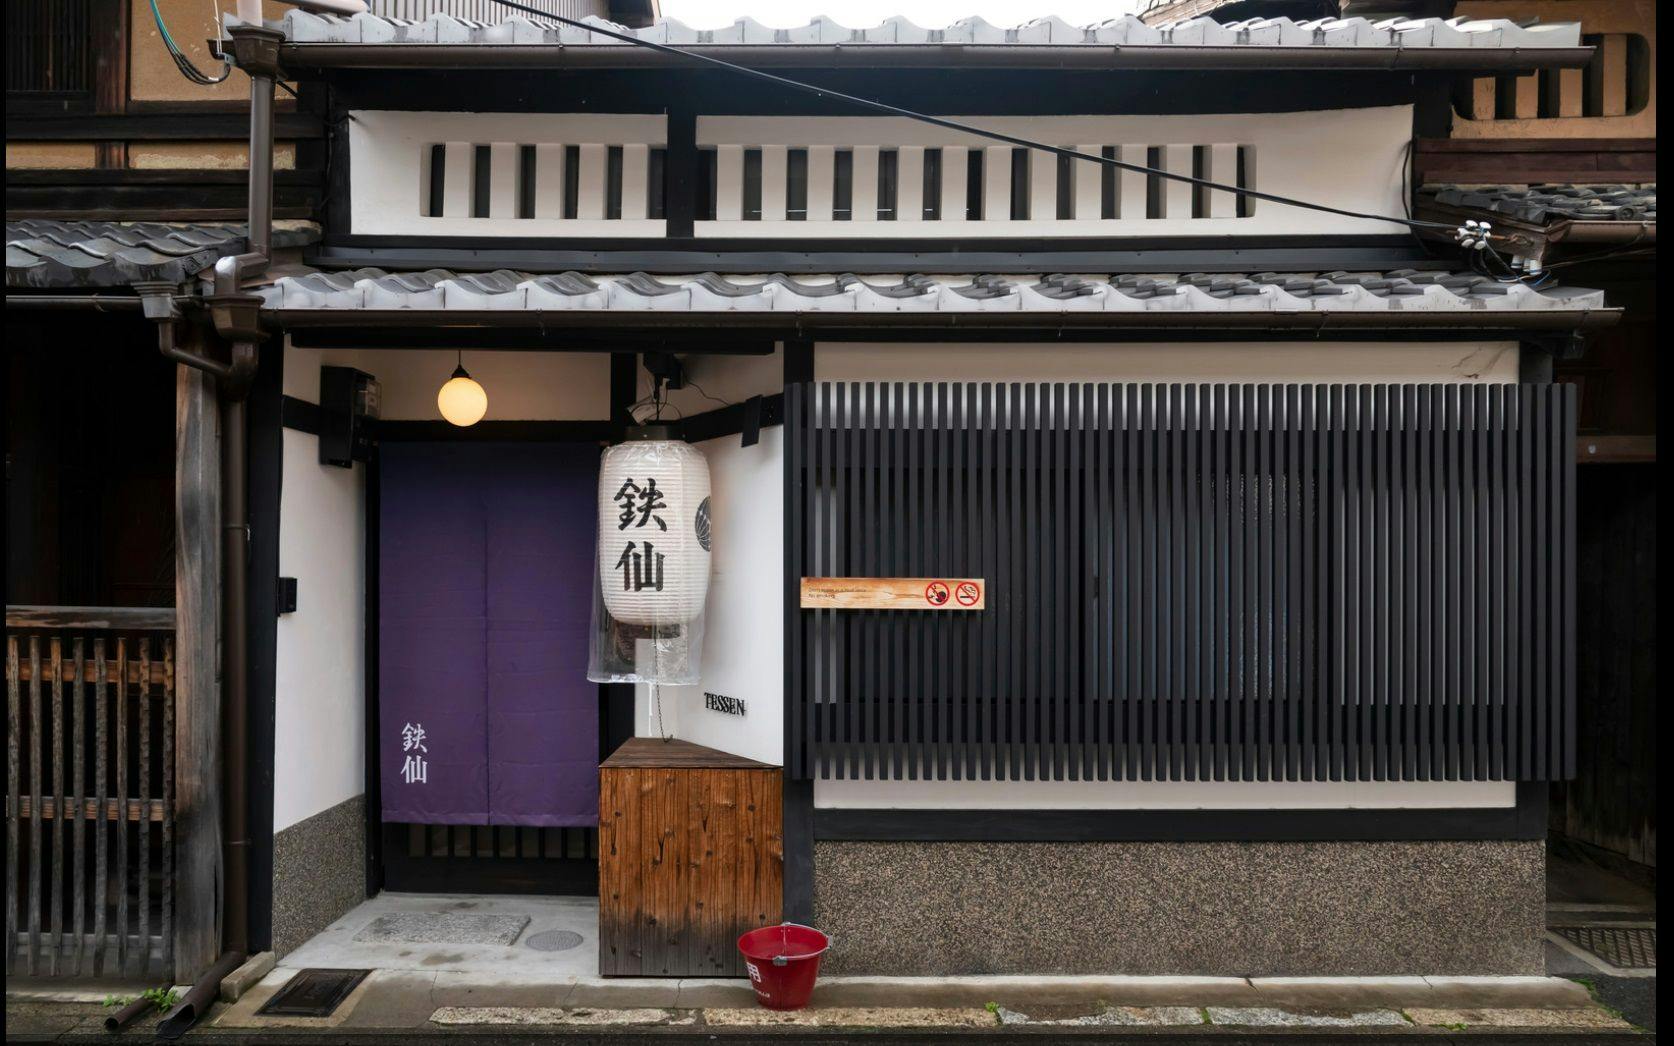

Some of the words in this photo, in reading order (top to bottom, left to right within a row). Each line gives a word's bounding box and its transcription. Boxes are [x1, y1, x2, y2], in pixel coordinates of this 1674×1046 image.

[613, 477, 667, 592] 鉄仙
[703, 692, 745, 716] TESSEN
[400, 722, 428, 784] 鉄仙
